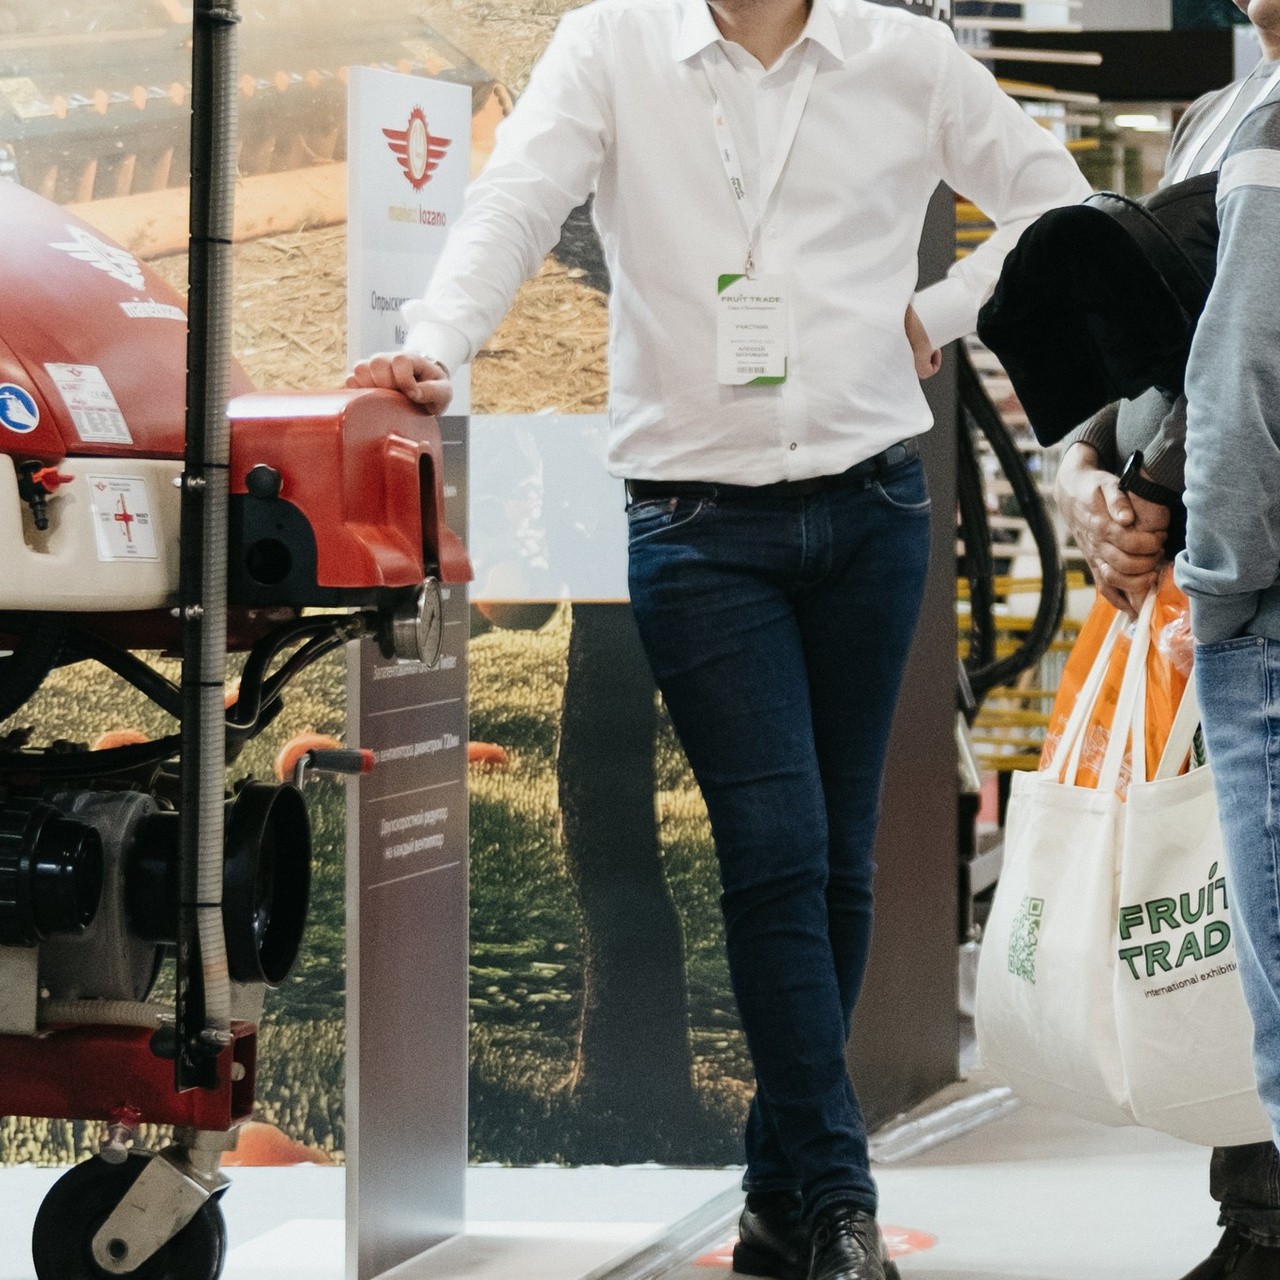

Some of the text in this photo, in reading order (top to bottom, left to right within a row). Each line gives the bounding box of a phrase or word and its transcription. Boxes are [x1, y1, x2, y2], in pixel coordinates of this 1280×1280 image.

[419, 204, 447, 227] lozano
[1119, 861, 1229, 940] FRUIT
[1118, 920, 1234, 980] TRAD
[1144, 961, 1238, 998] international exhibiti
